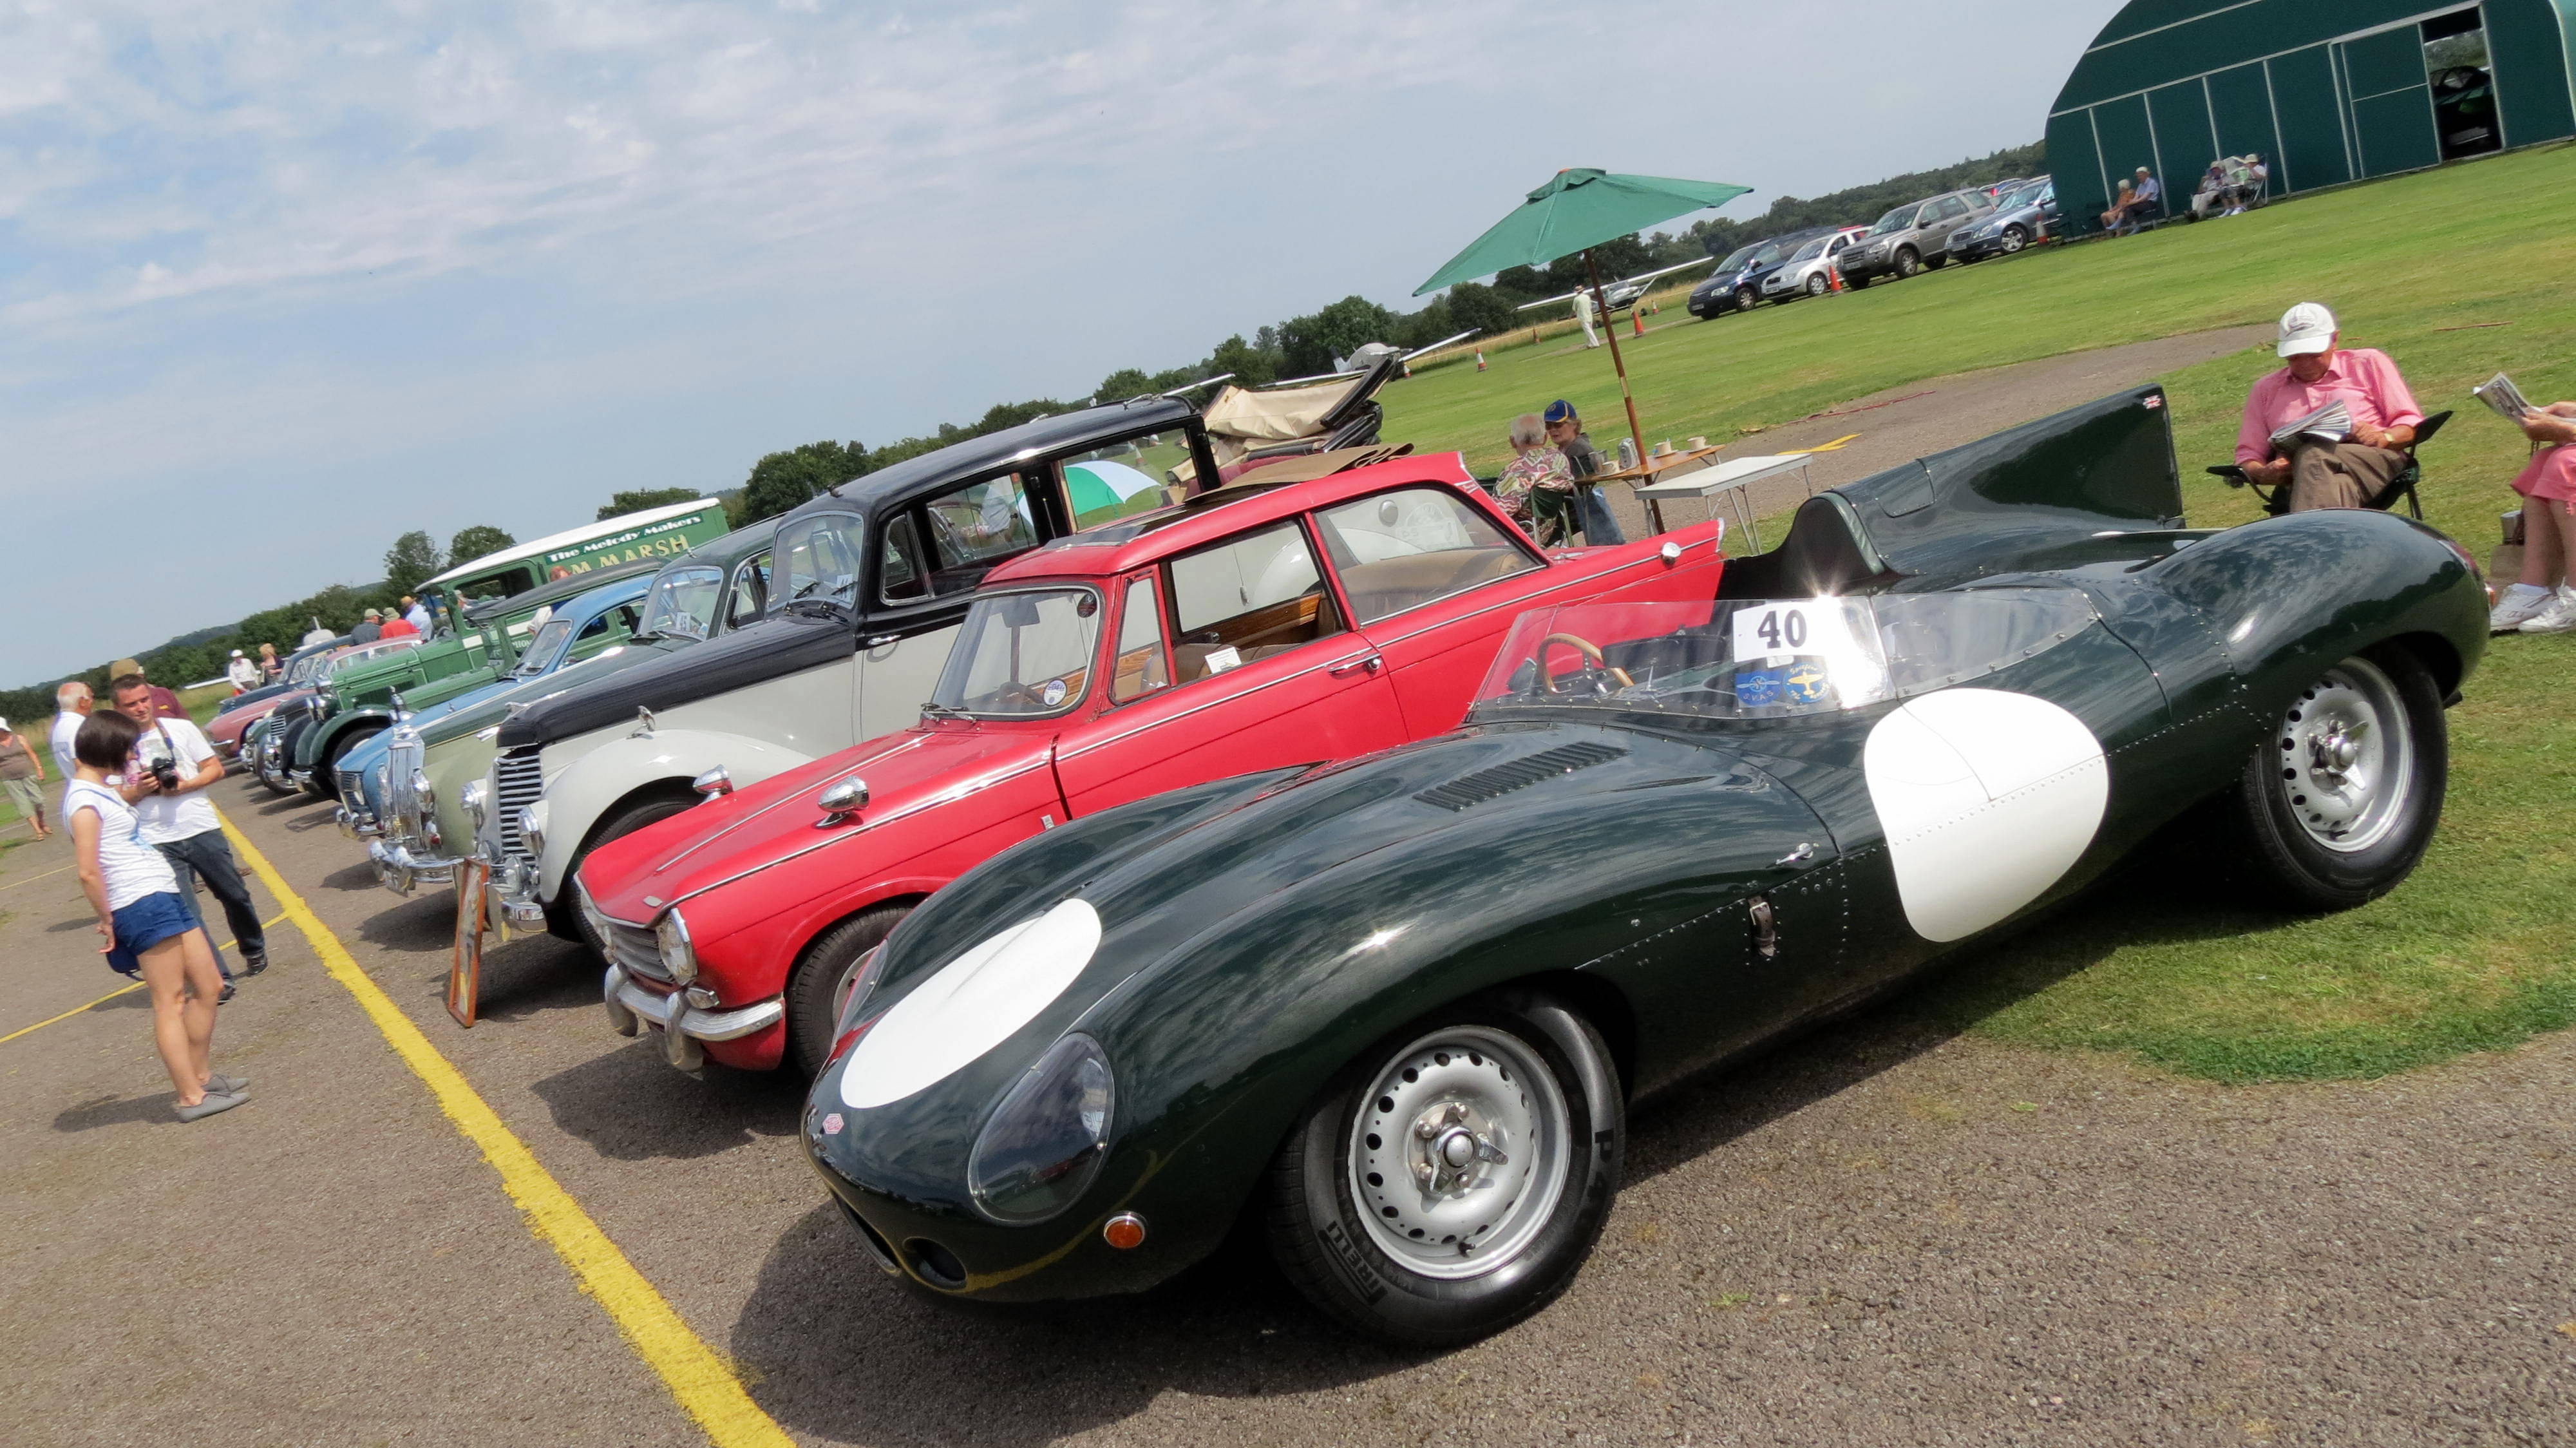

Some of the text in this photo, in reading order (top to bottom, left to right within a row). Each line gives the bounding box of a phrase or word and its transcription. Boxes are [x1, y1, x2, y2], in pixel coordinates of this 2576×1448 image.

[549, 516, 701, 562] The Melody Makers
[600, 535, 688, 567] MARSH
[1757, 609, 1807, 649] 40
[1318, 1221, 1388, 1305] PIRELLI
